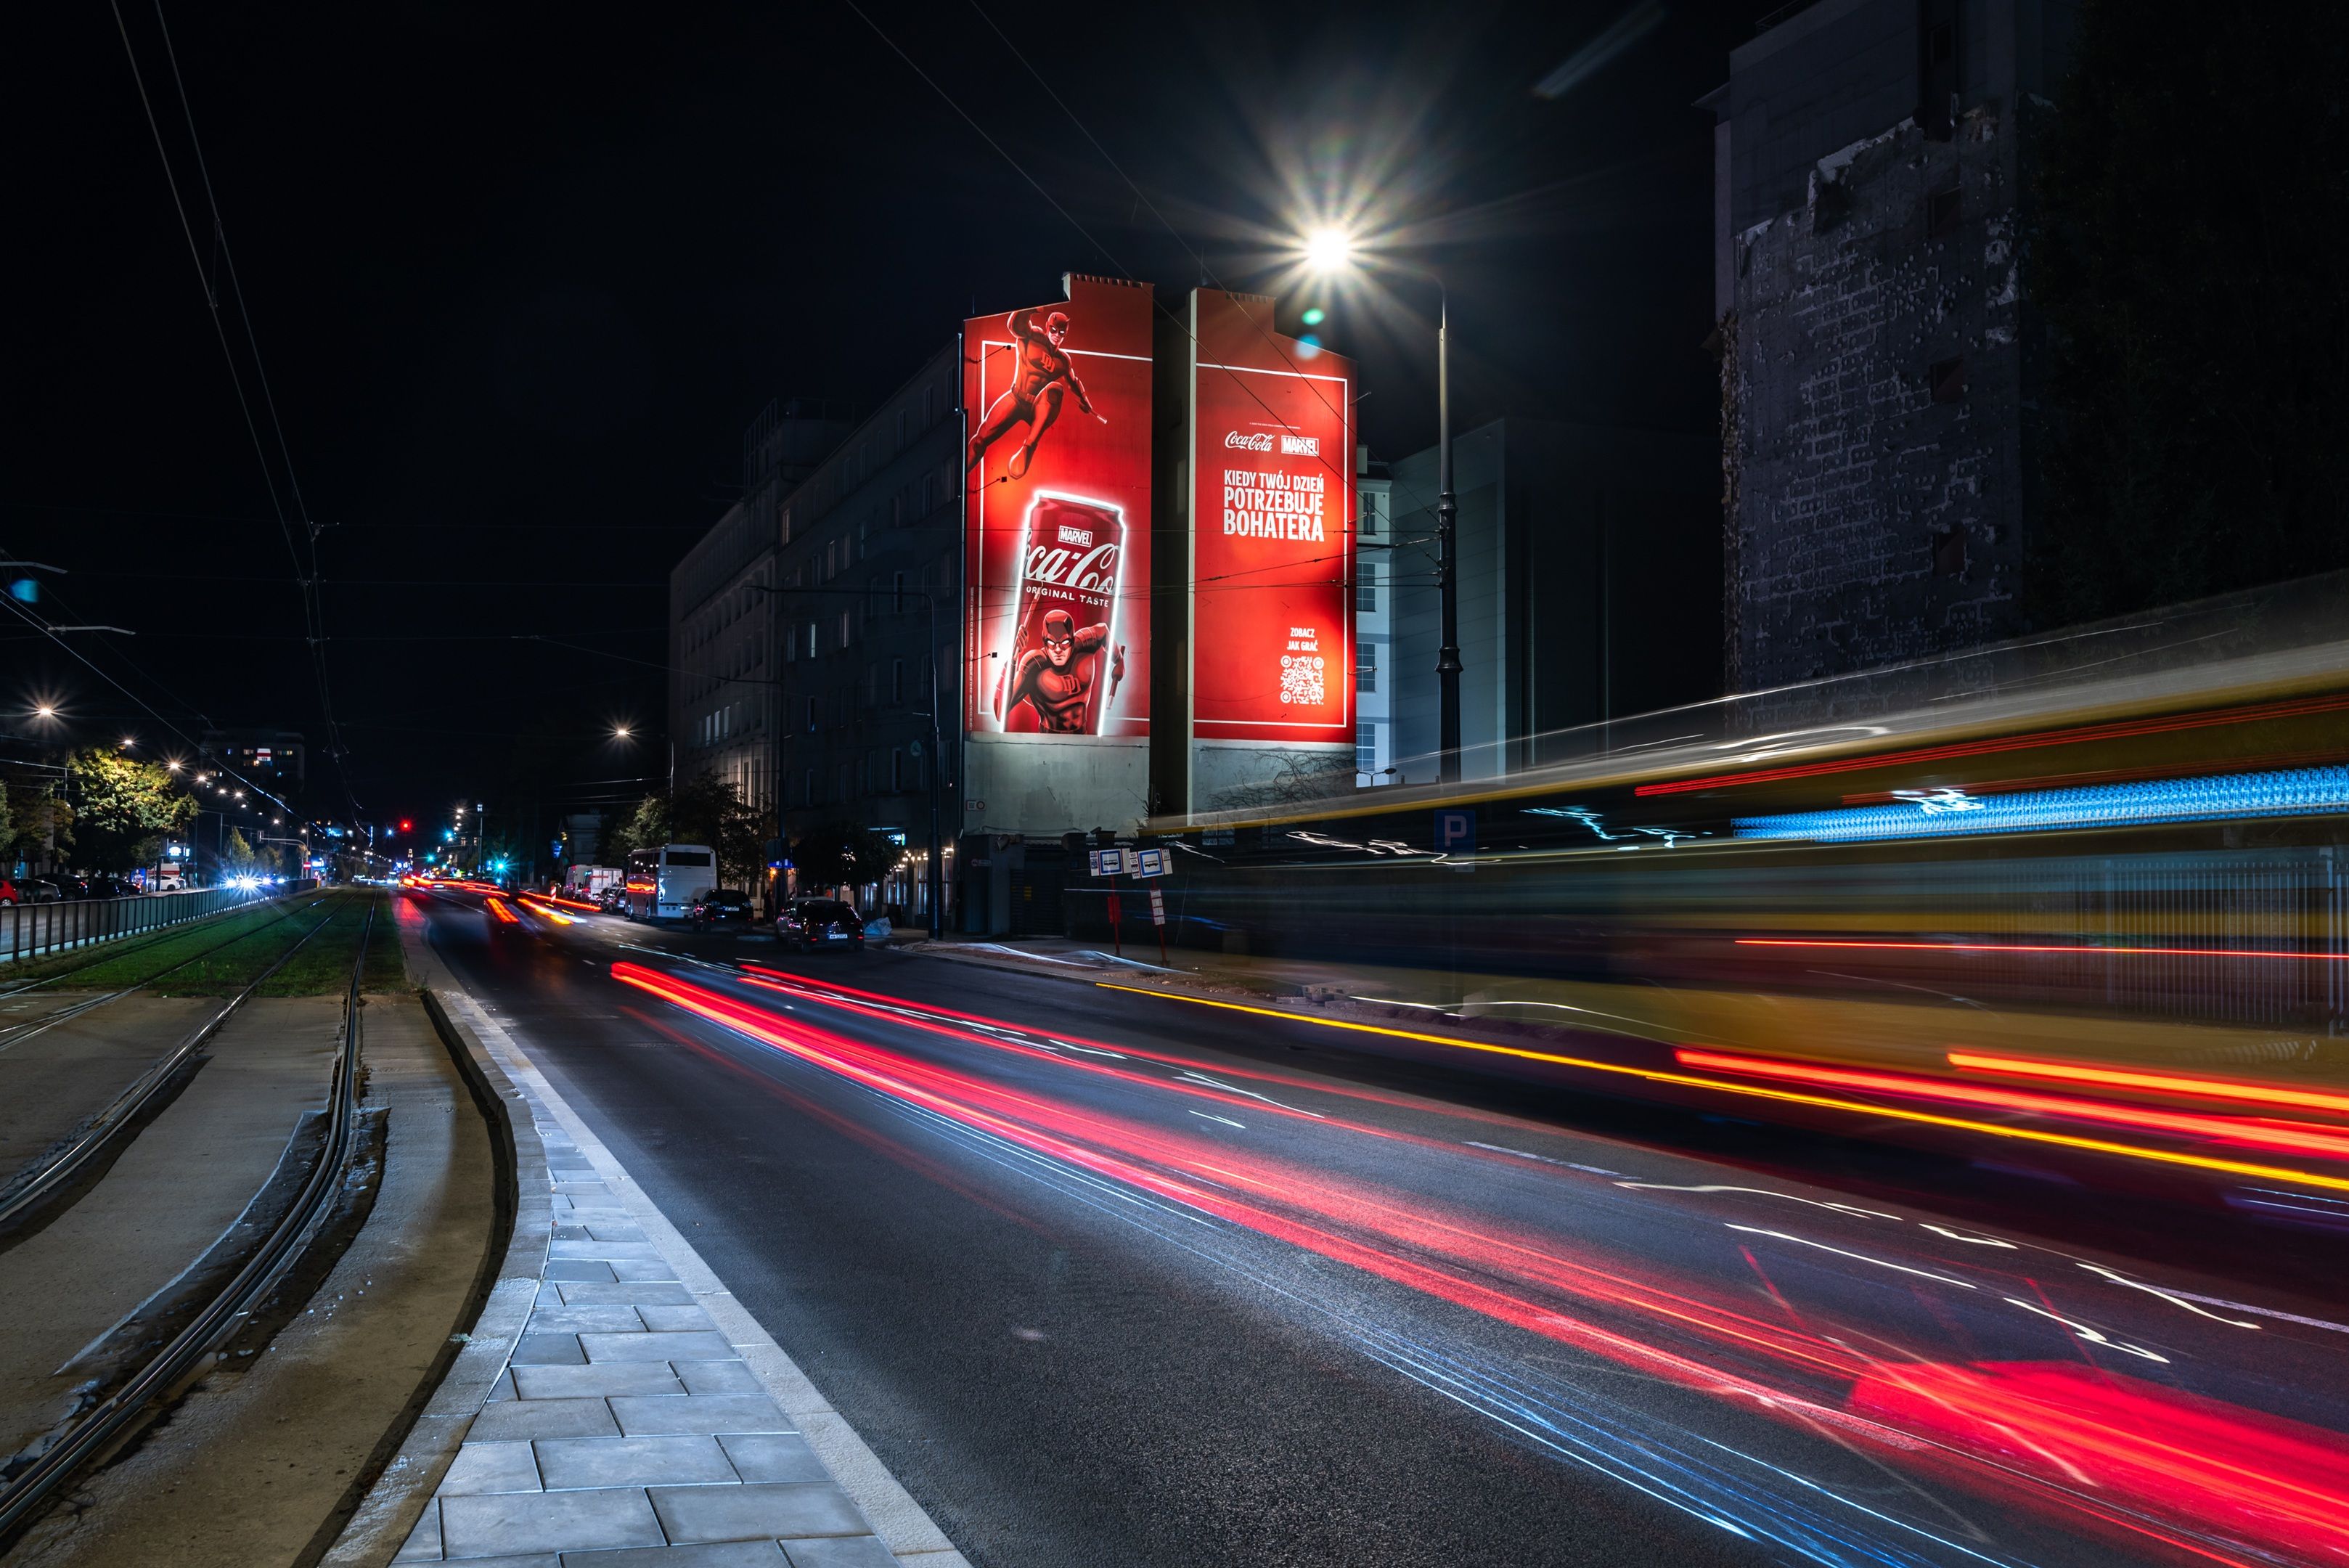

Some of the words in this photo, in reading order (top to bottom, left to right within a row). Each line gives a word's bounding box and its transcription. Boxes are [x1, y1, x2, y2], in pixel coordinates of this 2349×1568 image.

[1225, 430, 1275, 452] Coca-Cola
[1282, 436, 1318, 456] MARVEL
[1224, 470, 1257, 487] KIEDY
[1259, 470, 1291, 490] TWÓJ
[1293, 473, 1324, 493] DZIEŃ
[1224, 486, 1324, 515] POTRZEBUJE
[1060, 528, 1090, 545] MARVEL
[1224, 509, 1325, 542] BOHATERA
[1026, 586, 1075, 601] ORIGINAL
[1079, 595, 1108, 608] TASTE
[1290, 627, 1315, 638] ZOBACZ
[1286, 640, 1300, 651] JAK
[1300, 640, 1318, 652] GRAĆ
[1445, 815, 1467, 847] P
